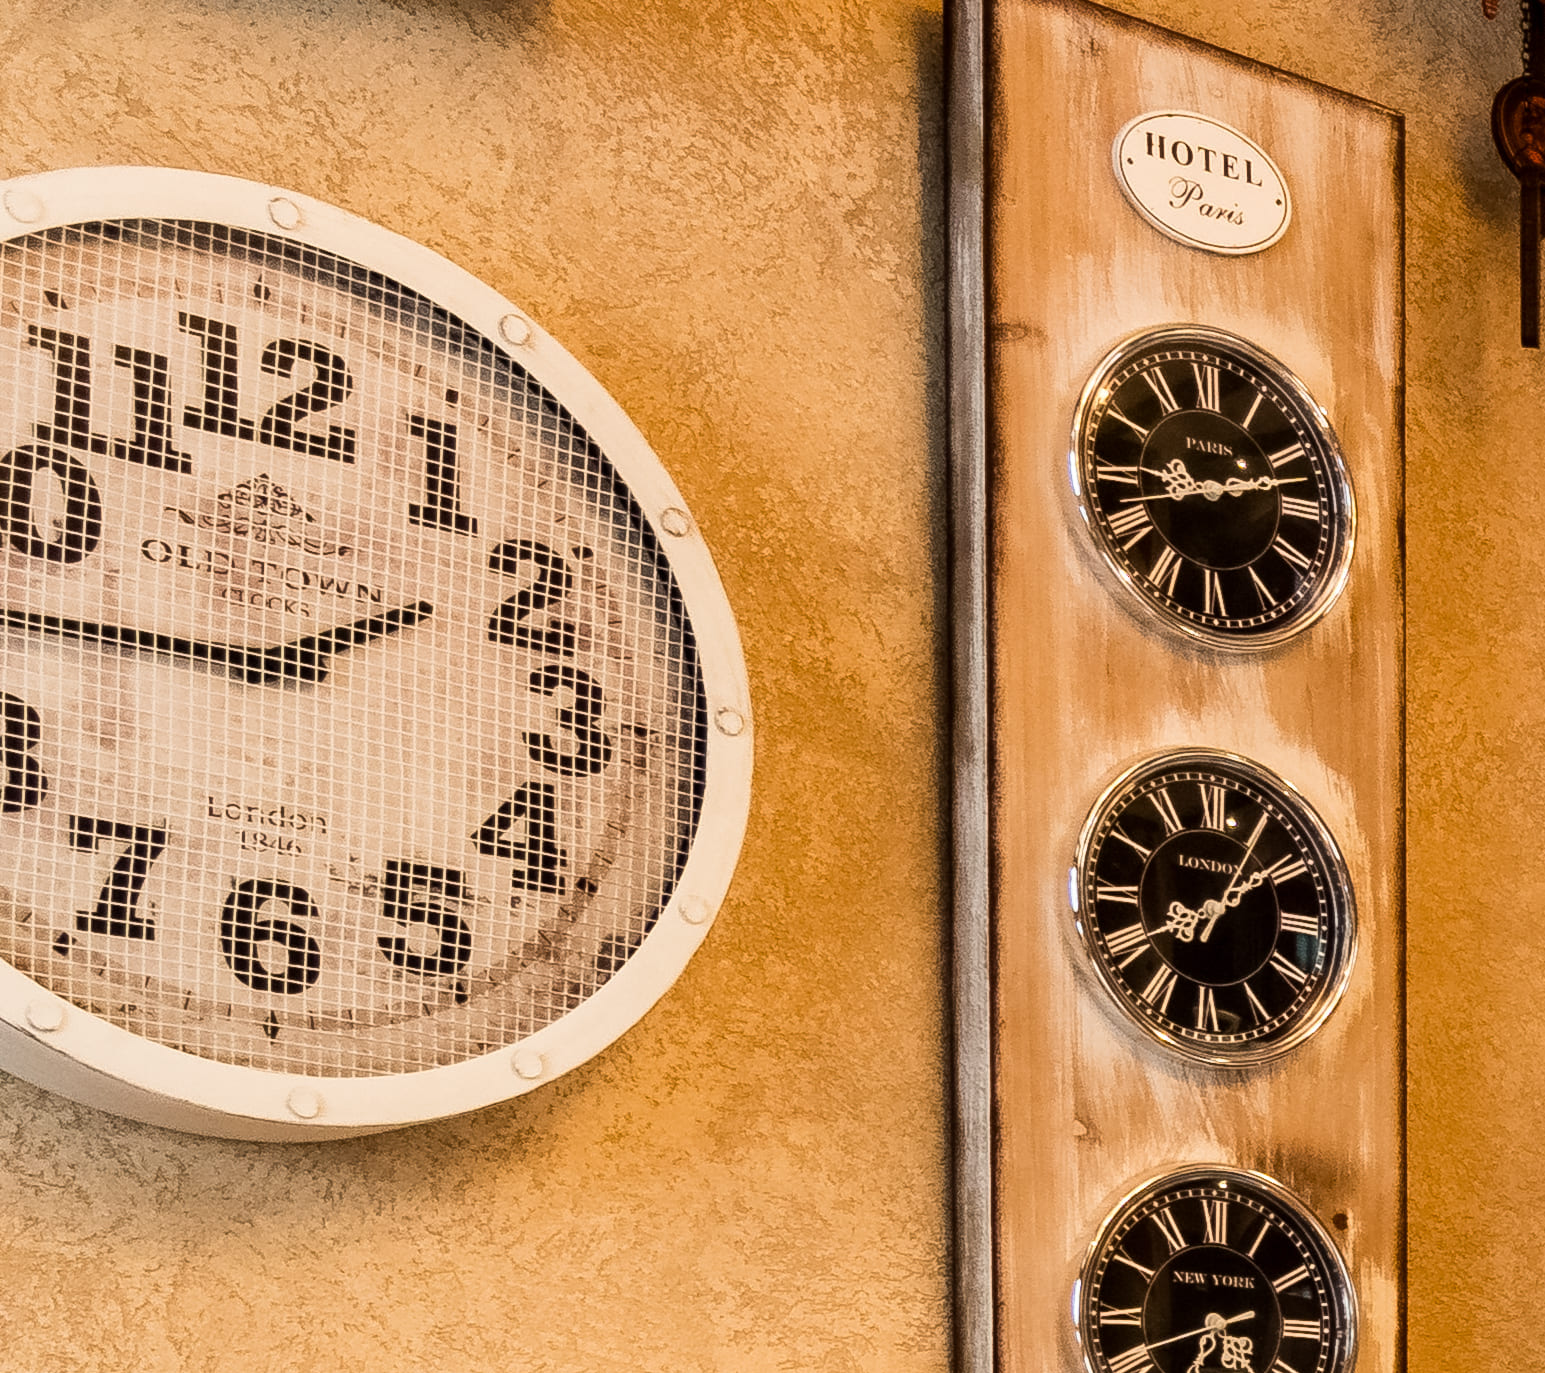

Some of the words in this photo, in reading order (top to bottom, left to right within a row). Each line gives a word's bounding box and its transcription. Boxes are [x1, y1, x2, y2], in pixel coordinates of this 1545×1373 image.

[1146, 132, 1263, 187] HOTEL
[1169, 176, 1244, 226] Paris
[28, 325, 192, 474] 11
[178, 311, 355, 464] 12
[408, 410, 477, 536] 1
[1185, 436, 1233, 456] PARIS
[0, 445, 102, 564] 0
[141, 539, 234, 575] OLD
[251, 559, 382, 603] TOWN
[221, 587, 310, 618] CLOCKS
[488, 537, 575, 657] 2
[522, 664, 611, 777] 3
[206, 796, 327, 835] London
[236, 830, 302, 857] 1846
[471, 781, 568, 896] 4
[1179, 854, 1242, 875] LONDON
[68, 812, 171, 943] 7
[377, 858, 472, 977] 5
[221, 877, 321, 995] 6
[1172, 1271, 1207, 1285] NEW
[1212, 1274, 1255, 1289] YORK
